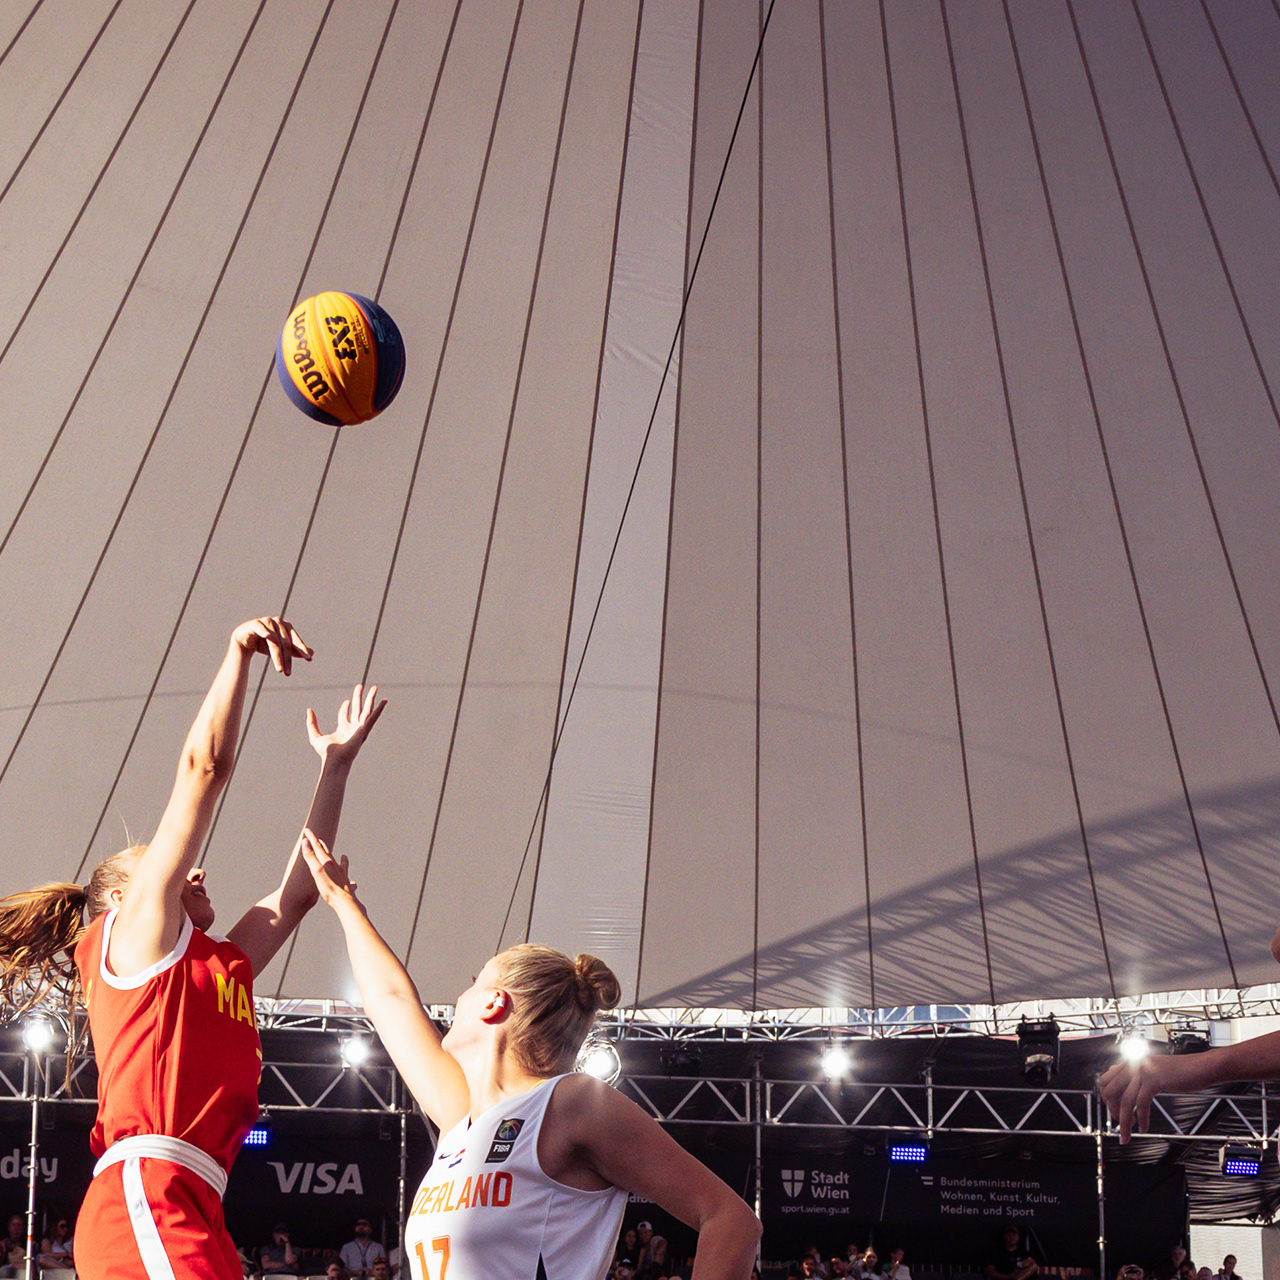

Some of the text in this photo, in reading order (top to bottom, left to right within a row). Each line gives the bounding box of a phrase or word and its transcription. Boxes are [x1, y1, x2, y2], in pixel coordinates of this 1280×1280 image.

[294, 311, 330, 401] Wilson
[216, 973, 258, 1034] MA
[266, 1161, 364, 1195] VISA
[811, 1171, 850, 1185] Stadt
[940, 1176, 1040, 1190] Bundesministerium
[811, 1185, 850, 1200] Wien
[940, 1190, 1061, 1205] Wohnen, Kunst, Kultur,
[781, 1204, 850, 1216] sport.wien.gv.at
[940, 1205, 1035, 1219] Medien und Sport
